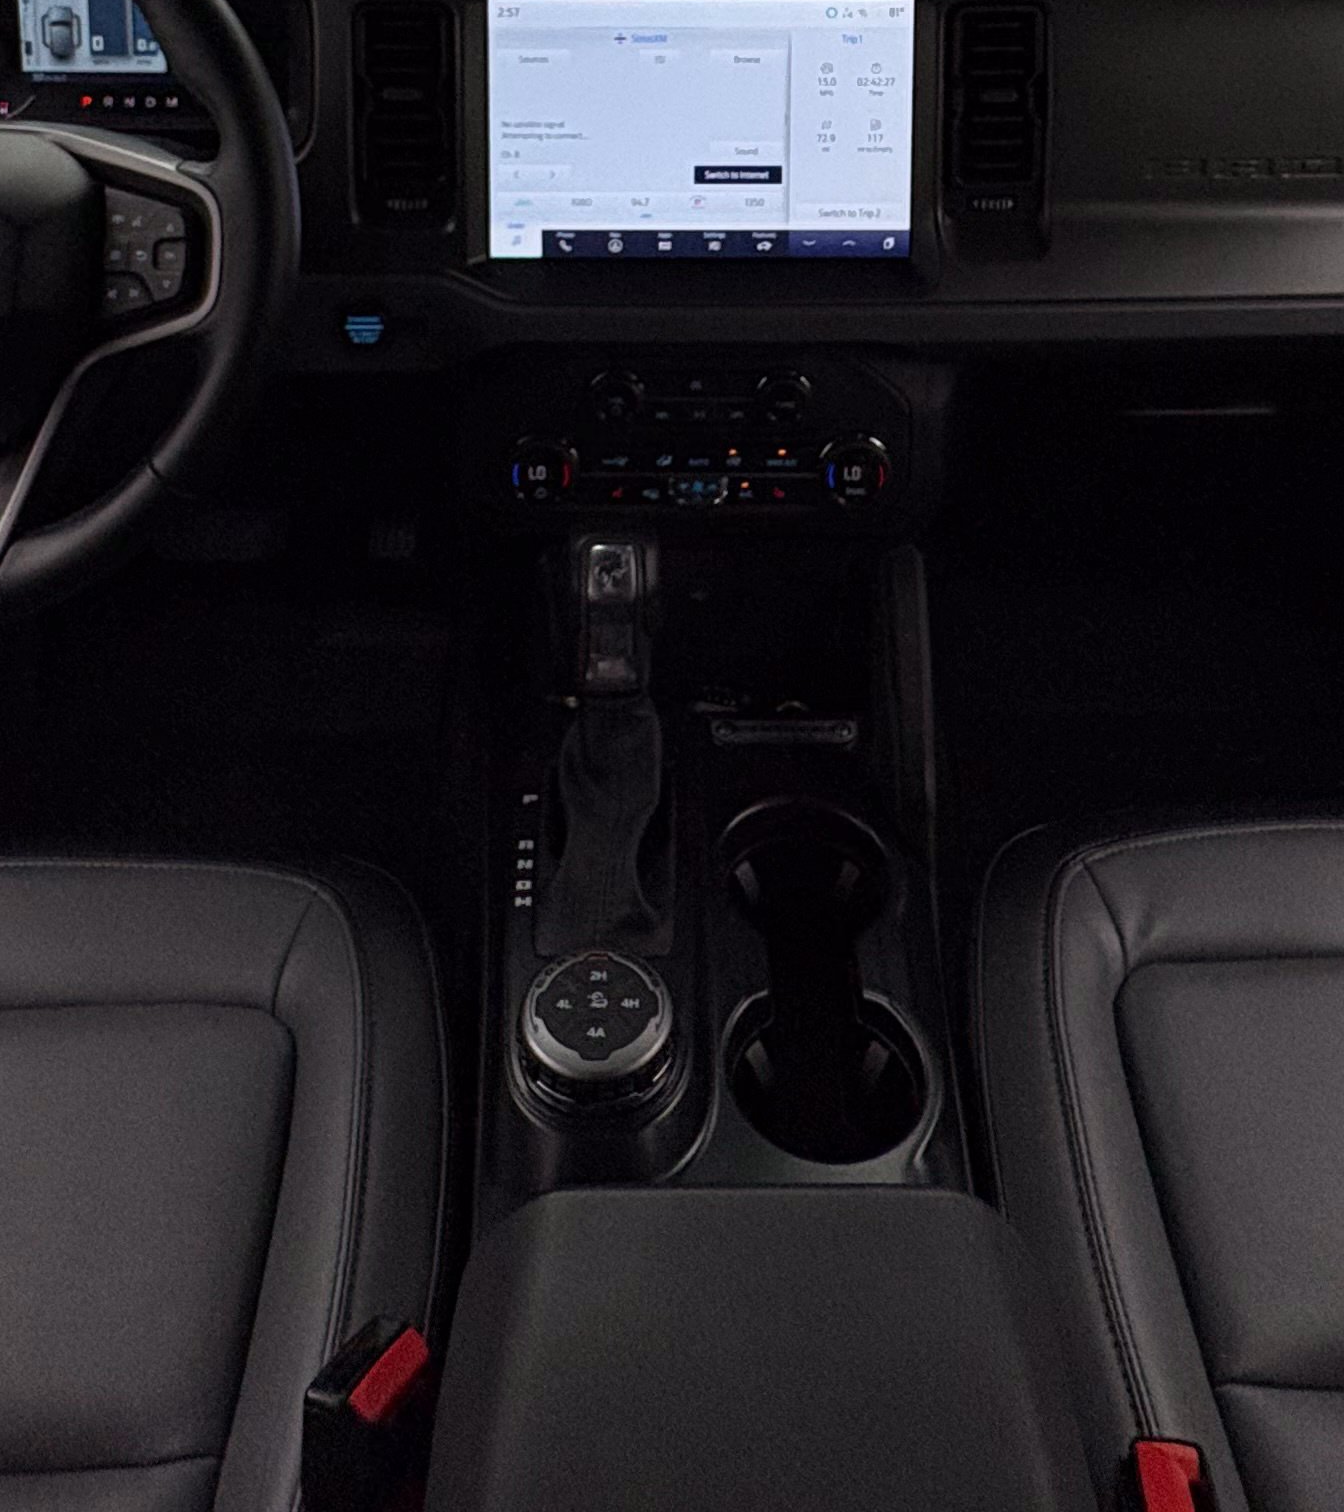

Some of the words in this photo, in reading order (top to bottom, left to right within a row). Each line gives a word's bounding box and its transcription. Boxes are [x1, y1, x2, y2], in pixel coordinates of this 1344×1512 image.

[497, 7, 520, 18] 2:57
[80, 96, 92, 108] P
[843, 465, 862, 481] LO
[589, 970, 608, 981] 2H
[556, 999, 573, 1009] 4L
[620, 998, 640, 1009] 4H
[586, 1026, 606, 1037] 4A
